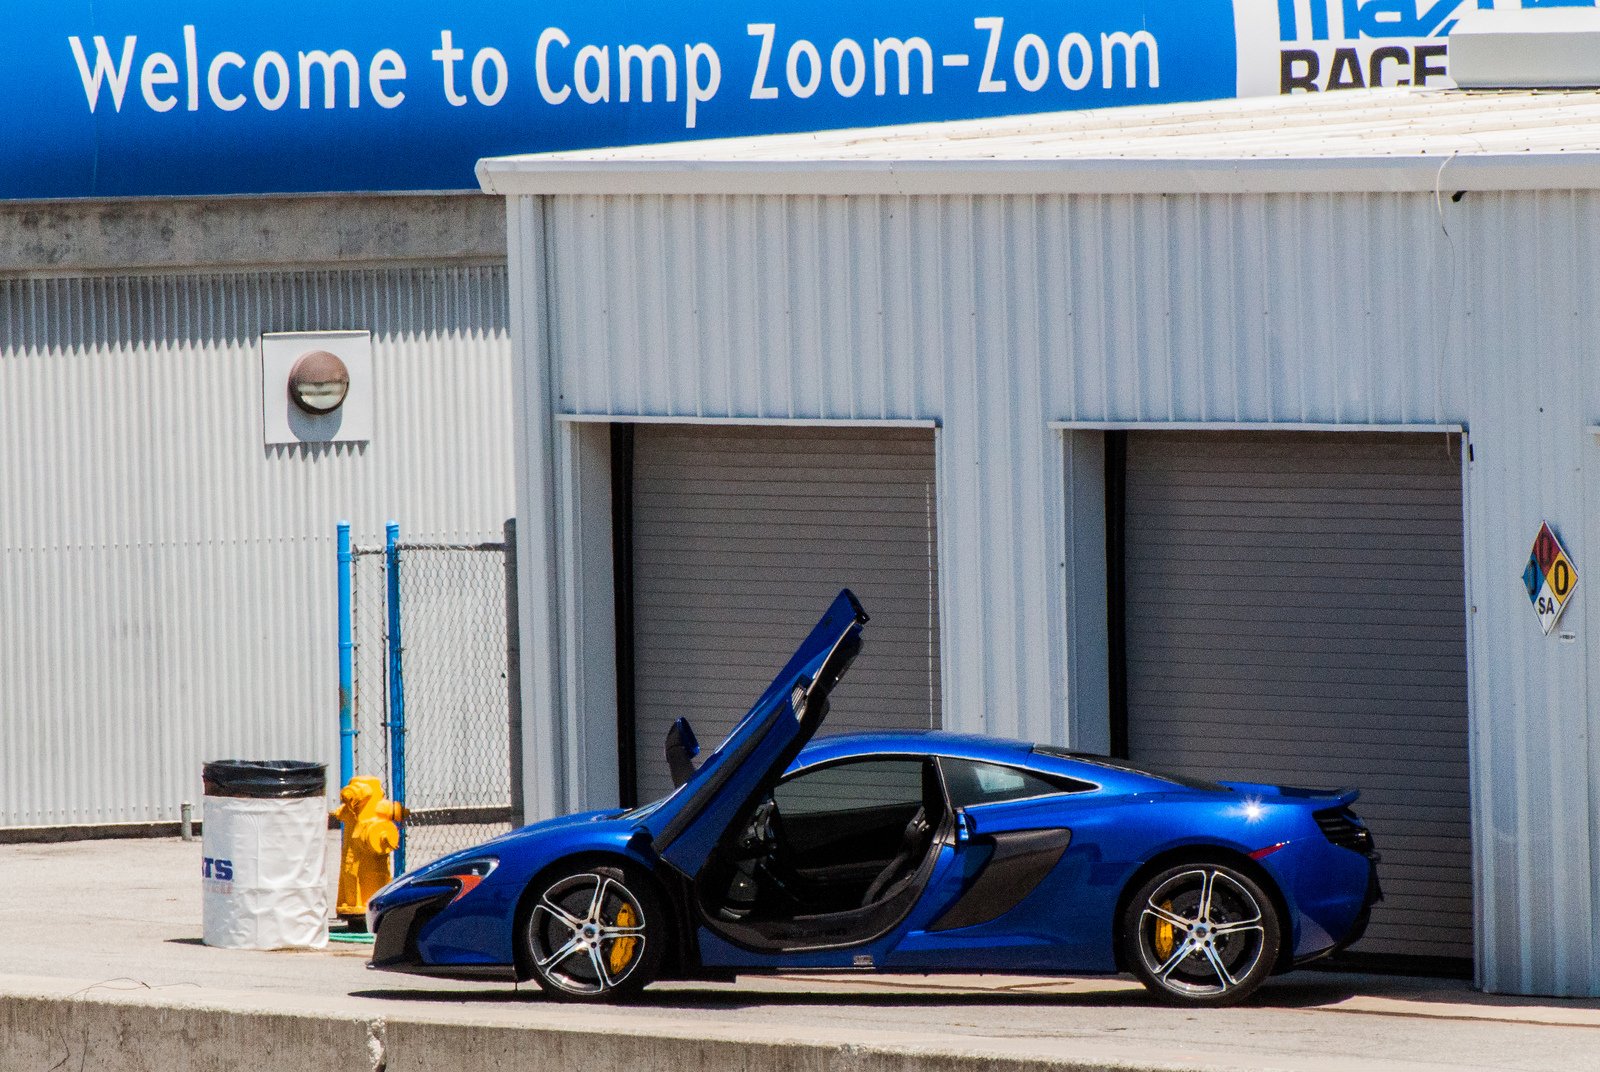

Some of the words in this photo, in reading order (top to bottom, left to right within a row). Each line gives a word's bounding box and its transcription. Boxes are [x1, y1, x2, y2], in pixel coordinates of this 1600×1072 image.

[68, 25, 407, 114] Welcome
[431, 29, 509, 107] to
[535, 27, 722, 129] Camp
[747, 16, 1160, 100] Zoom-Zoom
[1554, 559, 1569, 596] 0
[1538, 596, 1555, 615] SA
[202, 857, 234, 881] TS
